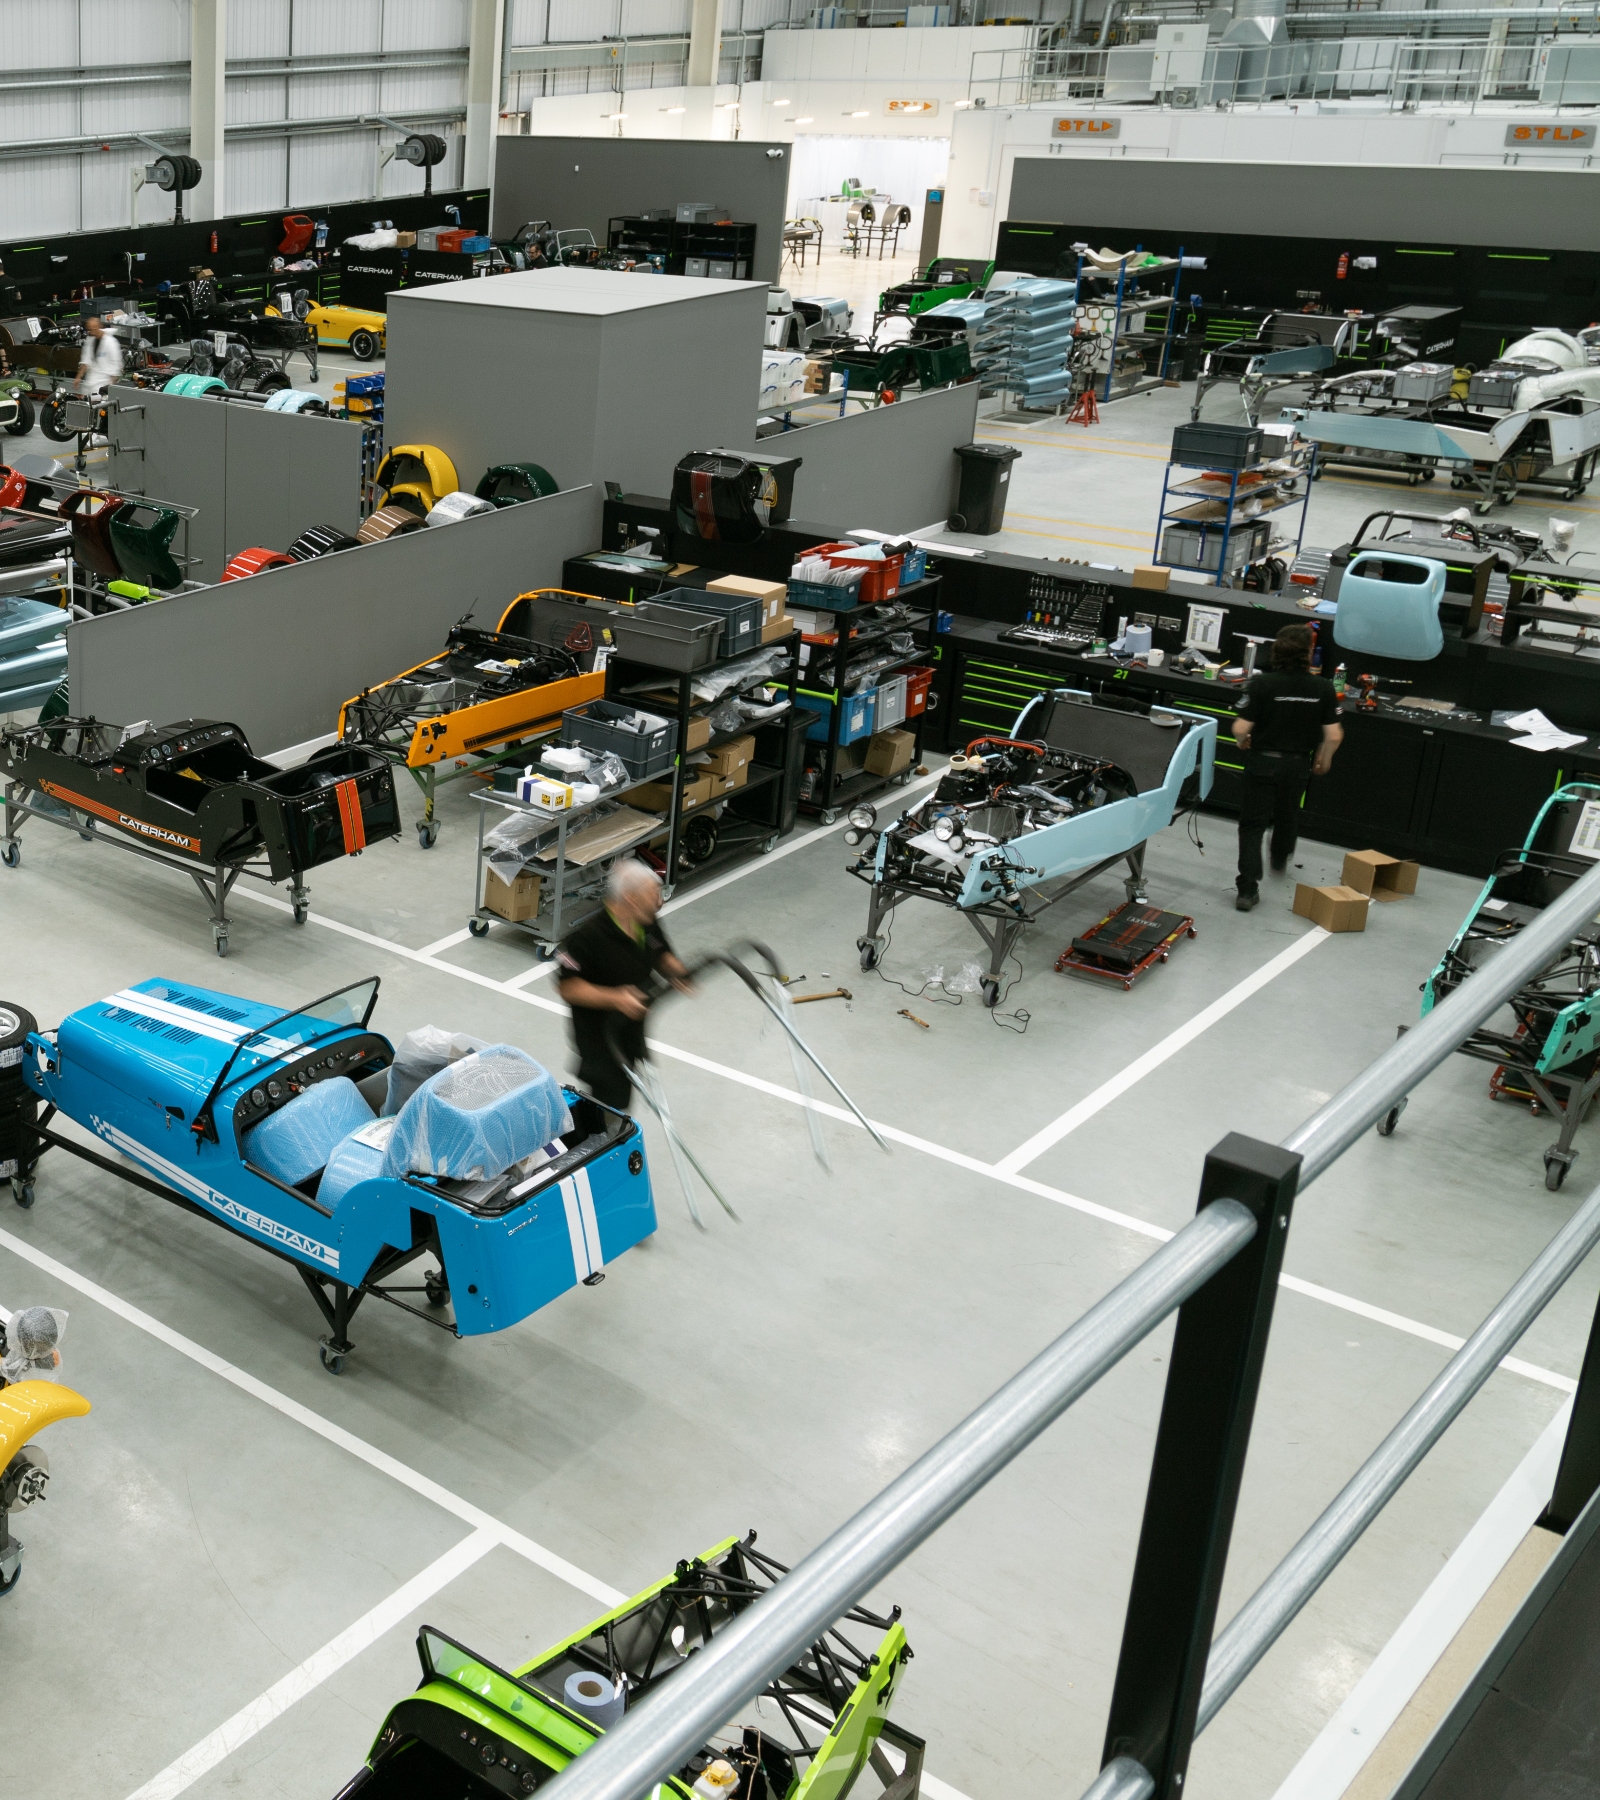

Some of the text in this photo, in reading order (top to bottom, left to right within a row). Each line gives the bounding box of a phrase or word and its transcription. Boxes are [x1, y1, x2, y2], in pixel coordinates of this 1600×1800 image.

[1058, 120, 1100, 132] STL
[1513, 126, 1569, 141] STL
[347, 265, 393, 276] CATERHAM
[414, 271, 464, 281] CATERHAM
[1425, 338, 1454, 355] CATERHAM
[1113, 669, 1129, 680] 21
[119, 815, 189, 847] CATERHAM
[211, 1191, 321, 1256] CATERHAM
